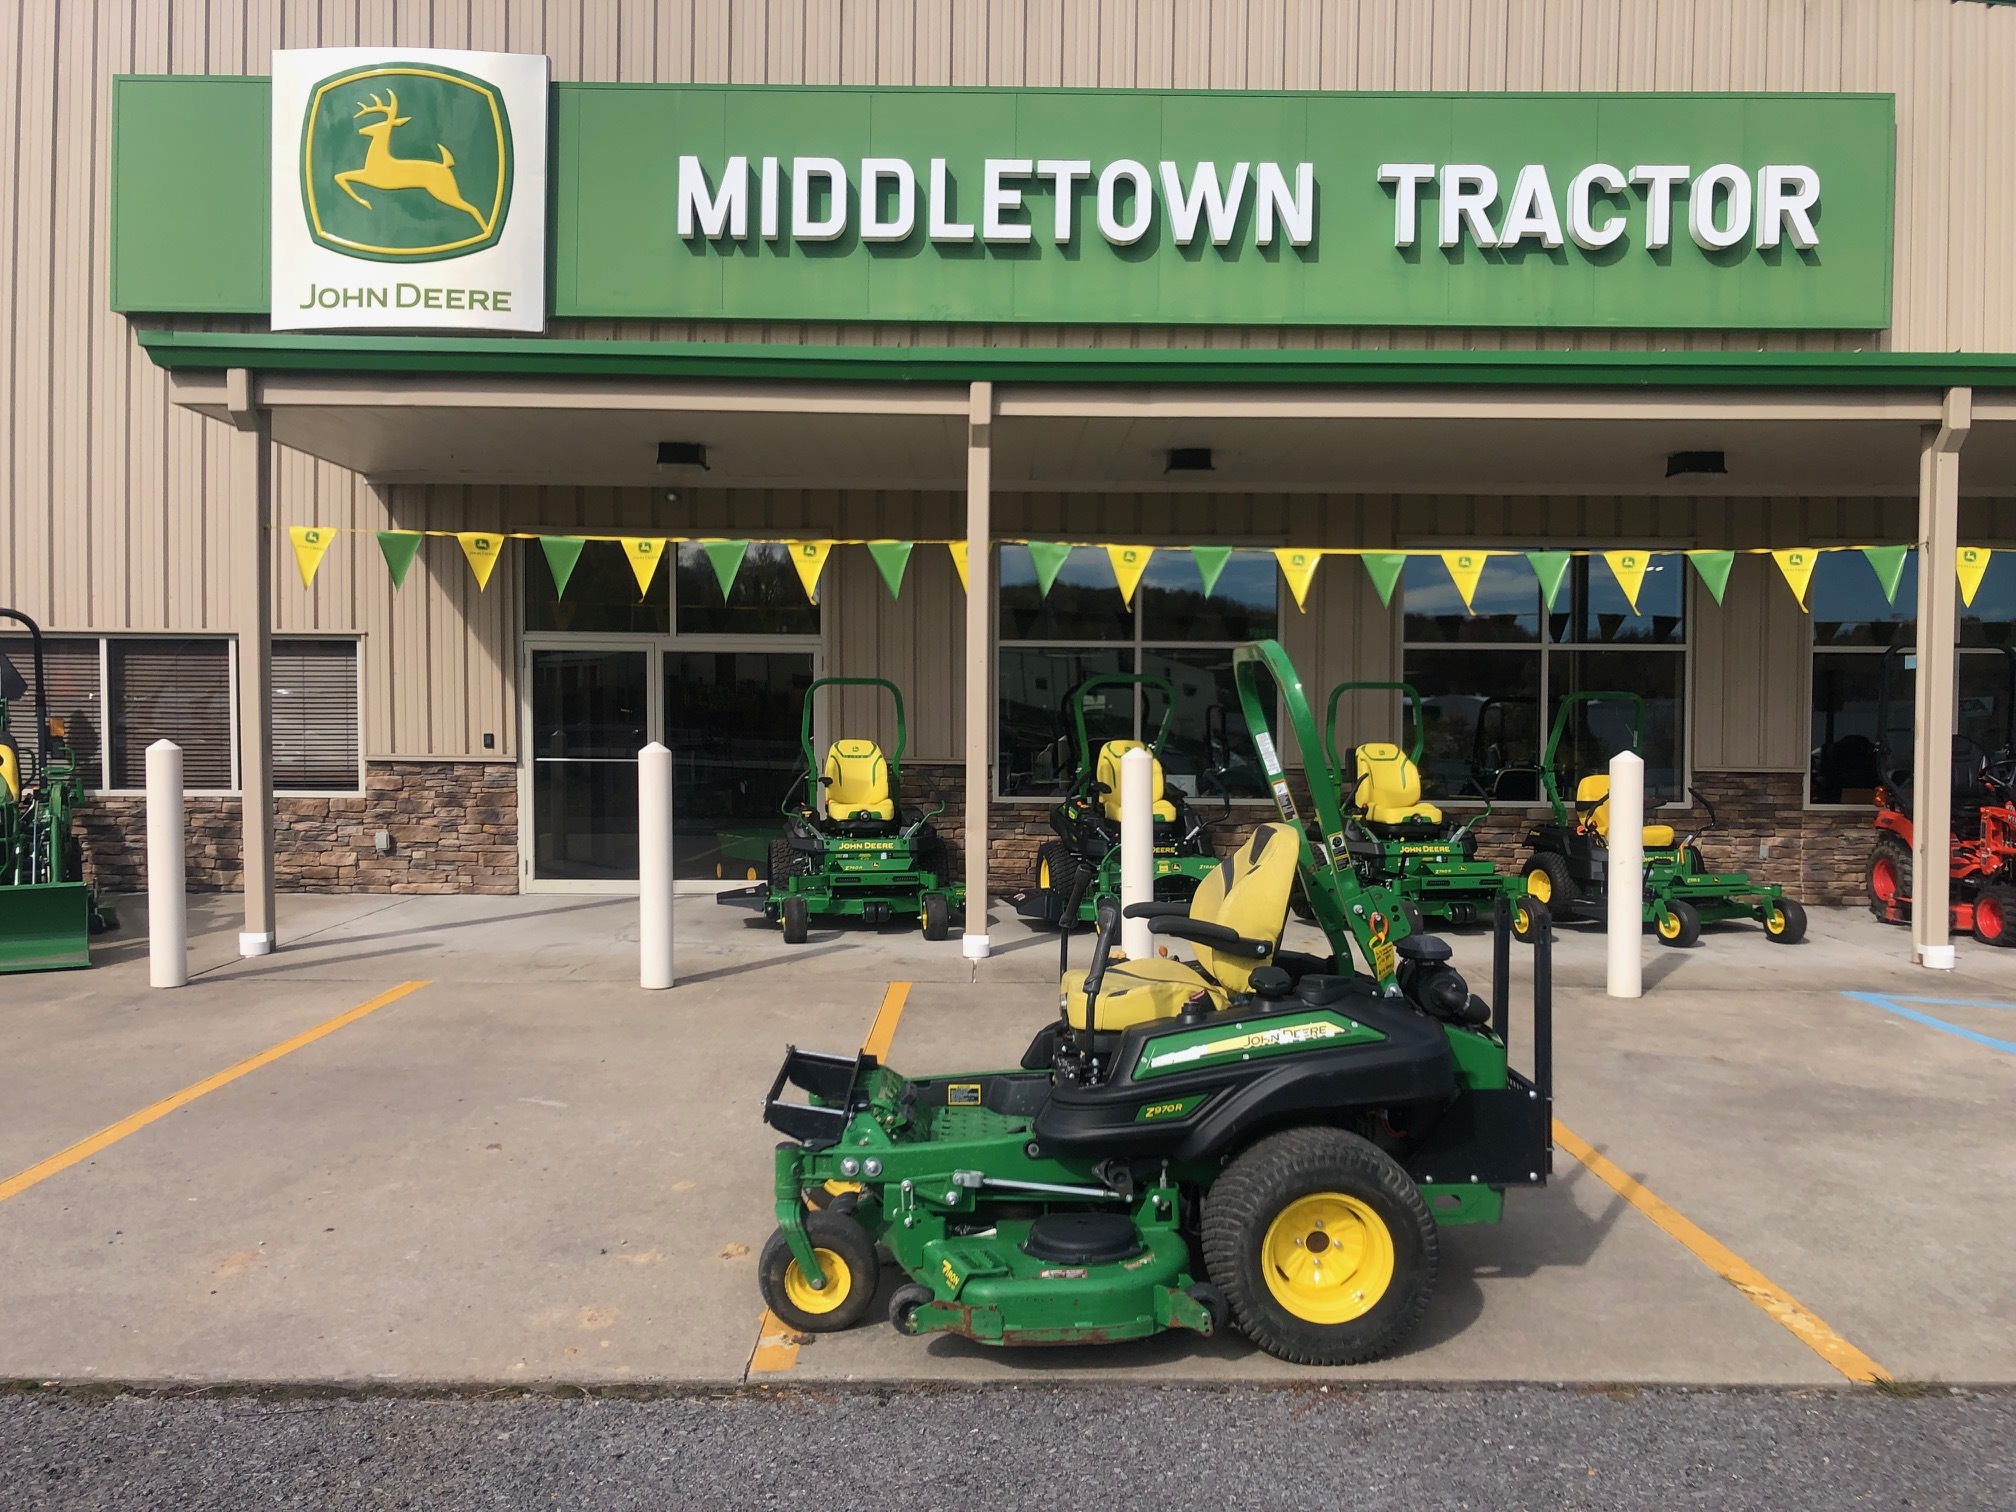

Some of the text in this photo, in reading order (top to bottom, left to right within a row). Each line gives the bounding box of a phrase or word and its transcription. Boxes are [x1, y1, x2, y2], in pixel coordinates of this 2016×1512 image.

[677, 156, 1820, 250] MIDDLETOWN TRACTOR
[300, 283, 512, 312] JOHN DEERE
[1400, 845, 1421, 853] JOHN
[1145, 1103, 1183, 1118] Z970R
